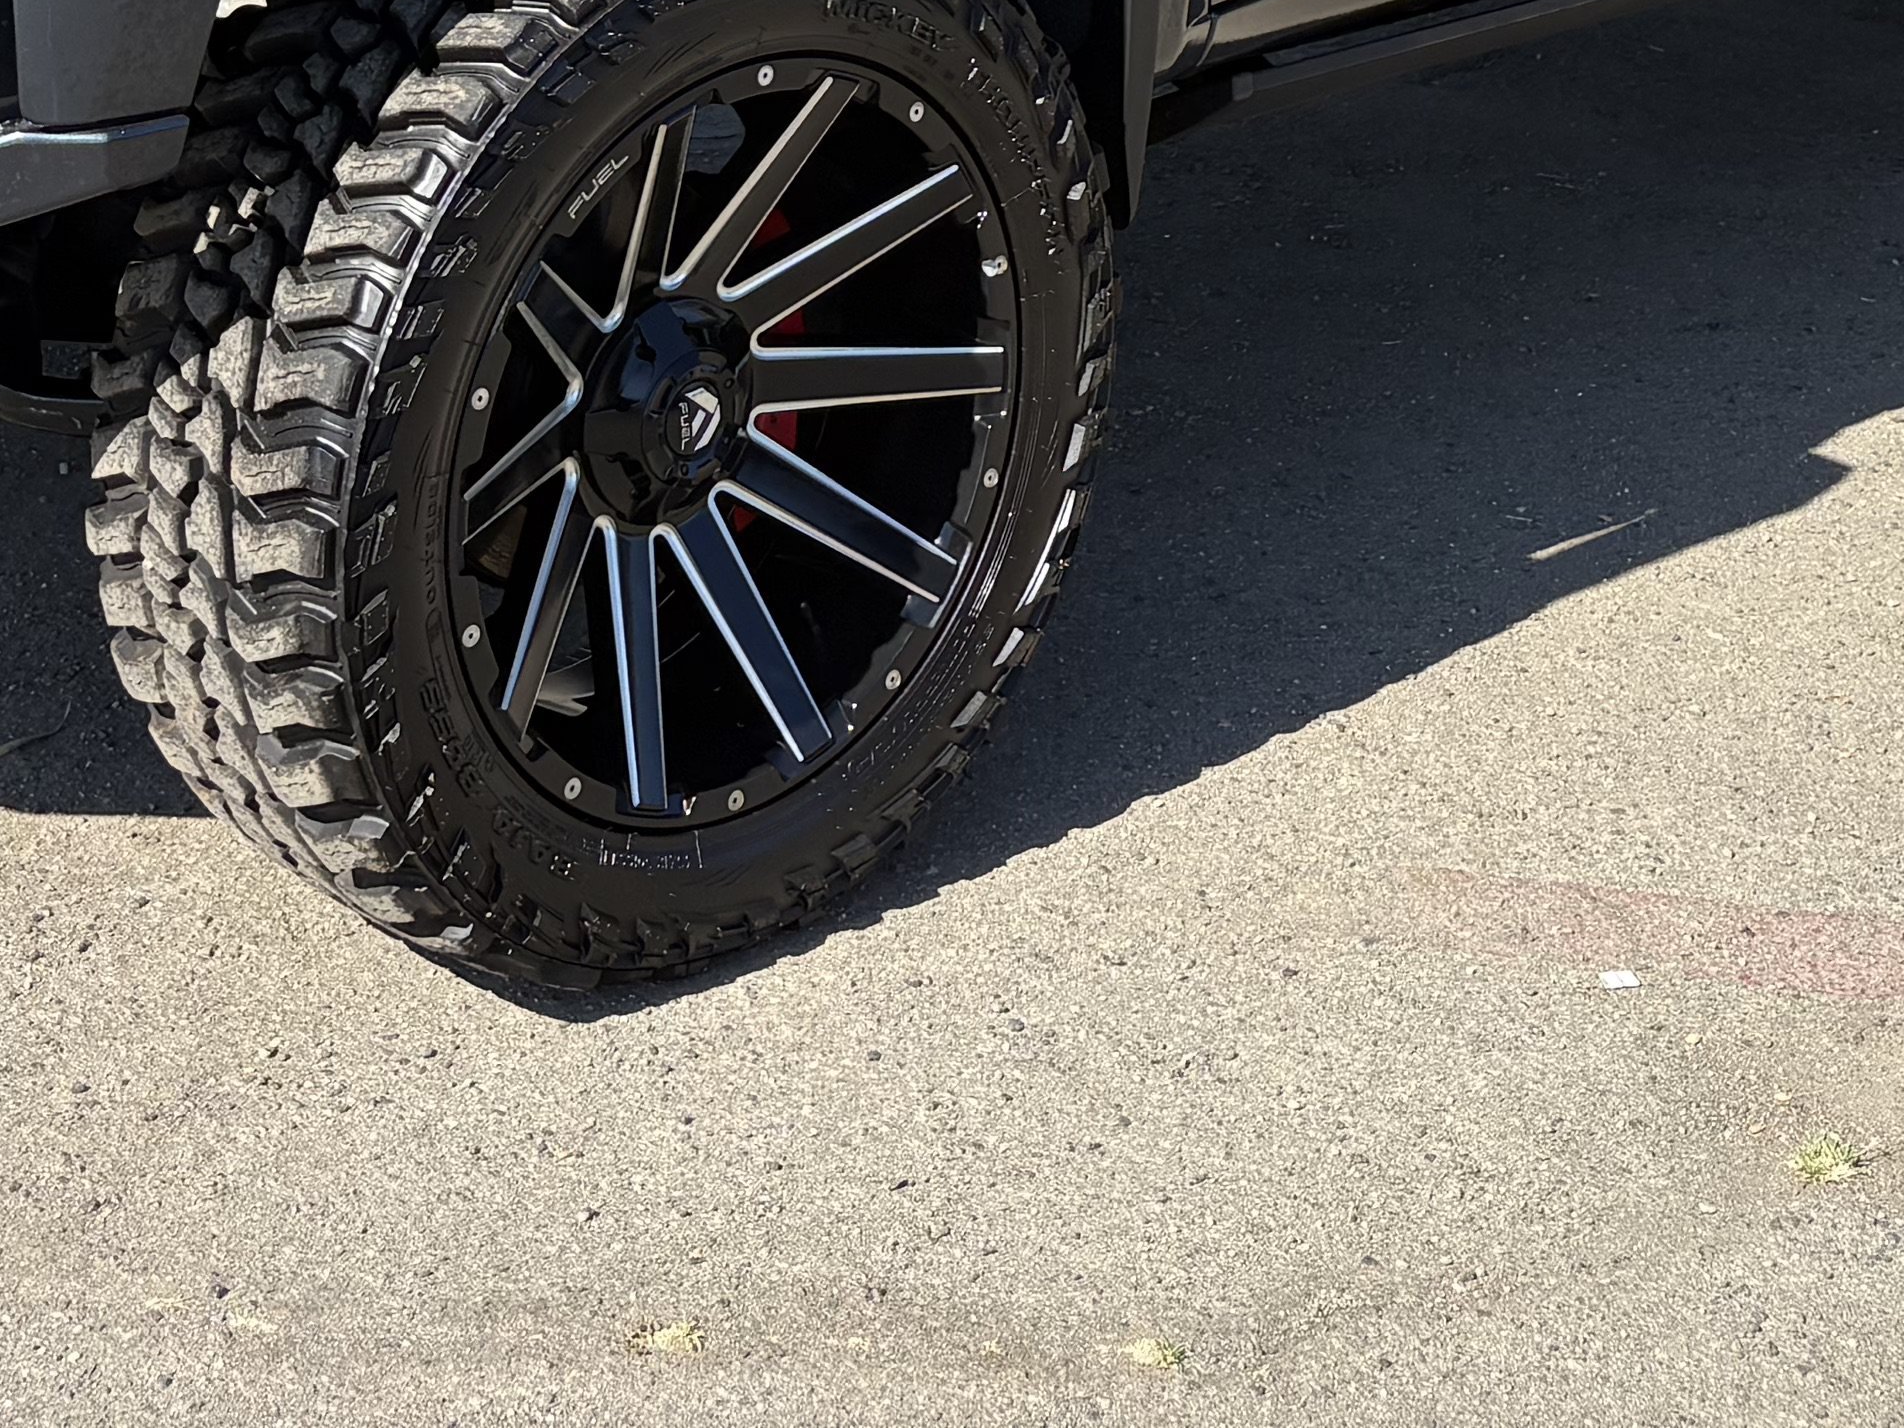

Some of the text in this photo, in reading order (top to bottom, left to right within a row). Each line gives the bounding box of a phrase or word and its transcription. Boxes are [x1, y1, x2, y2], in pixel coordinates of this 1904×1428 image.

[567, 155, 629, 219] FUEL
[678, 402, 691, 451] FUEL
[491, 806, 578, 882] BAJA
